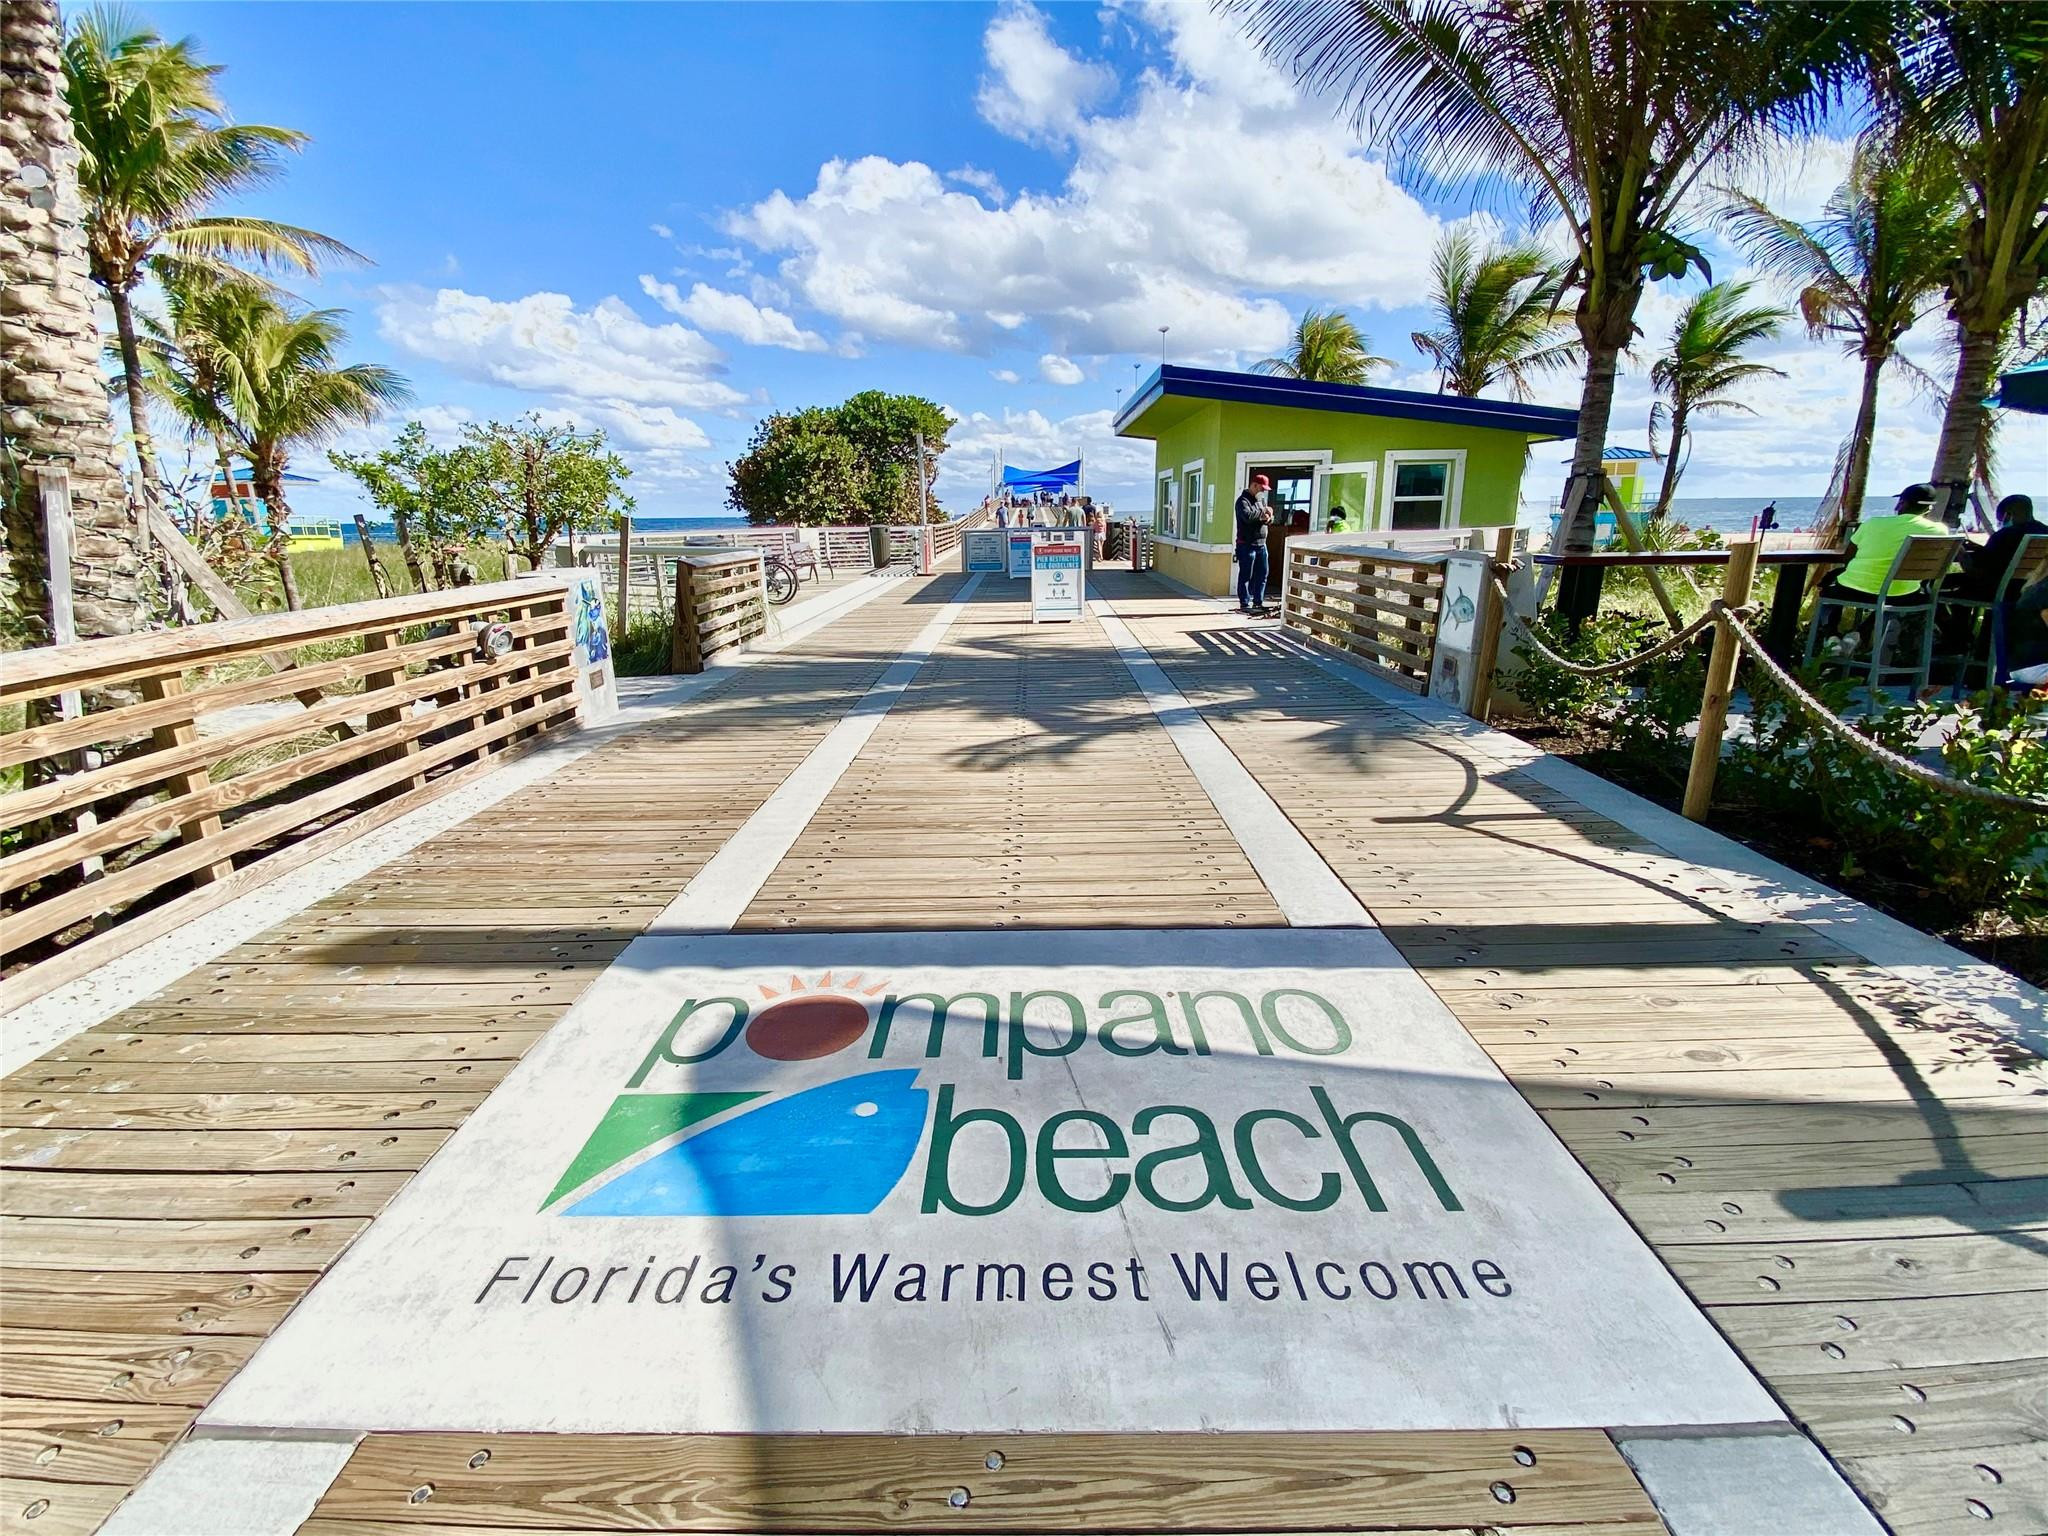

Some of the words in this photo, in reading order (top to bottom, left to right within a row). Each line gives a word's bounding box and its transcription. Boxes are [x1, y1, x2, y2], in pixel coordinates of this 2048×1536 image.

[624, 988, 1352, 1089] pompano
[920, 1083, 1464, 1215] beach
[474, 1253, 798, 1304] Florida's
[832, 1253, 1150, 1303] Warmest
[1170, 1250, 1513, 1302] Welcome
